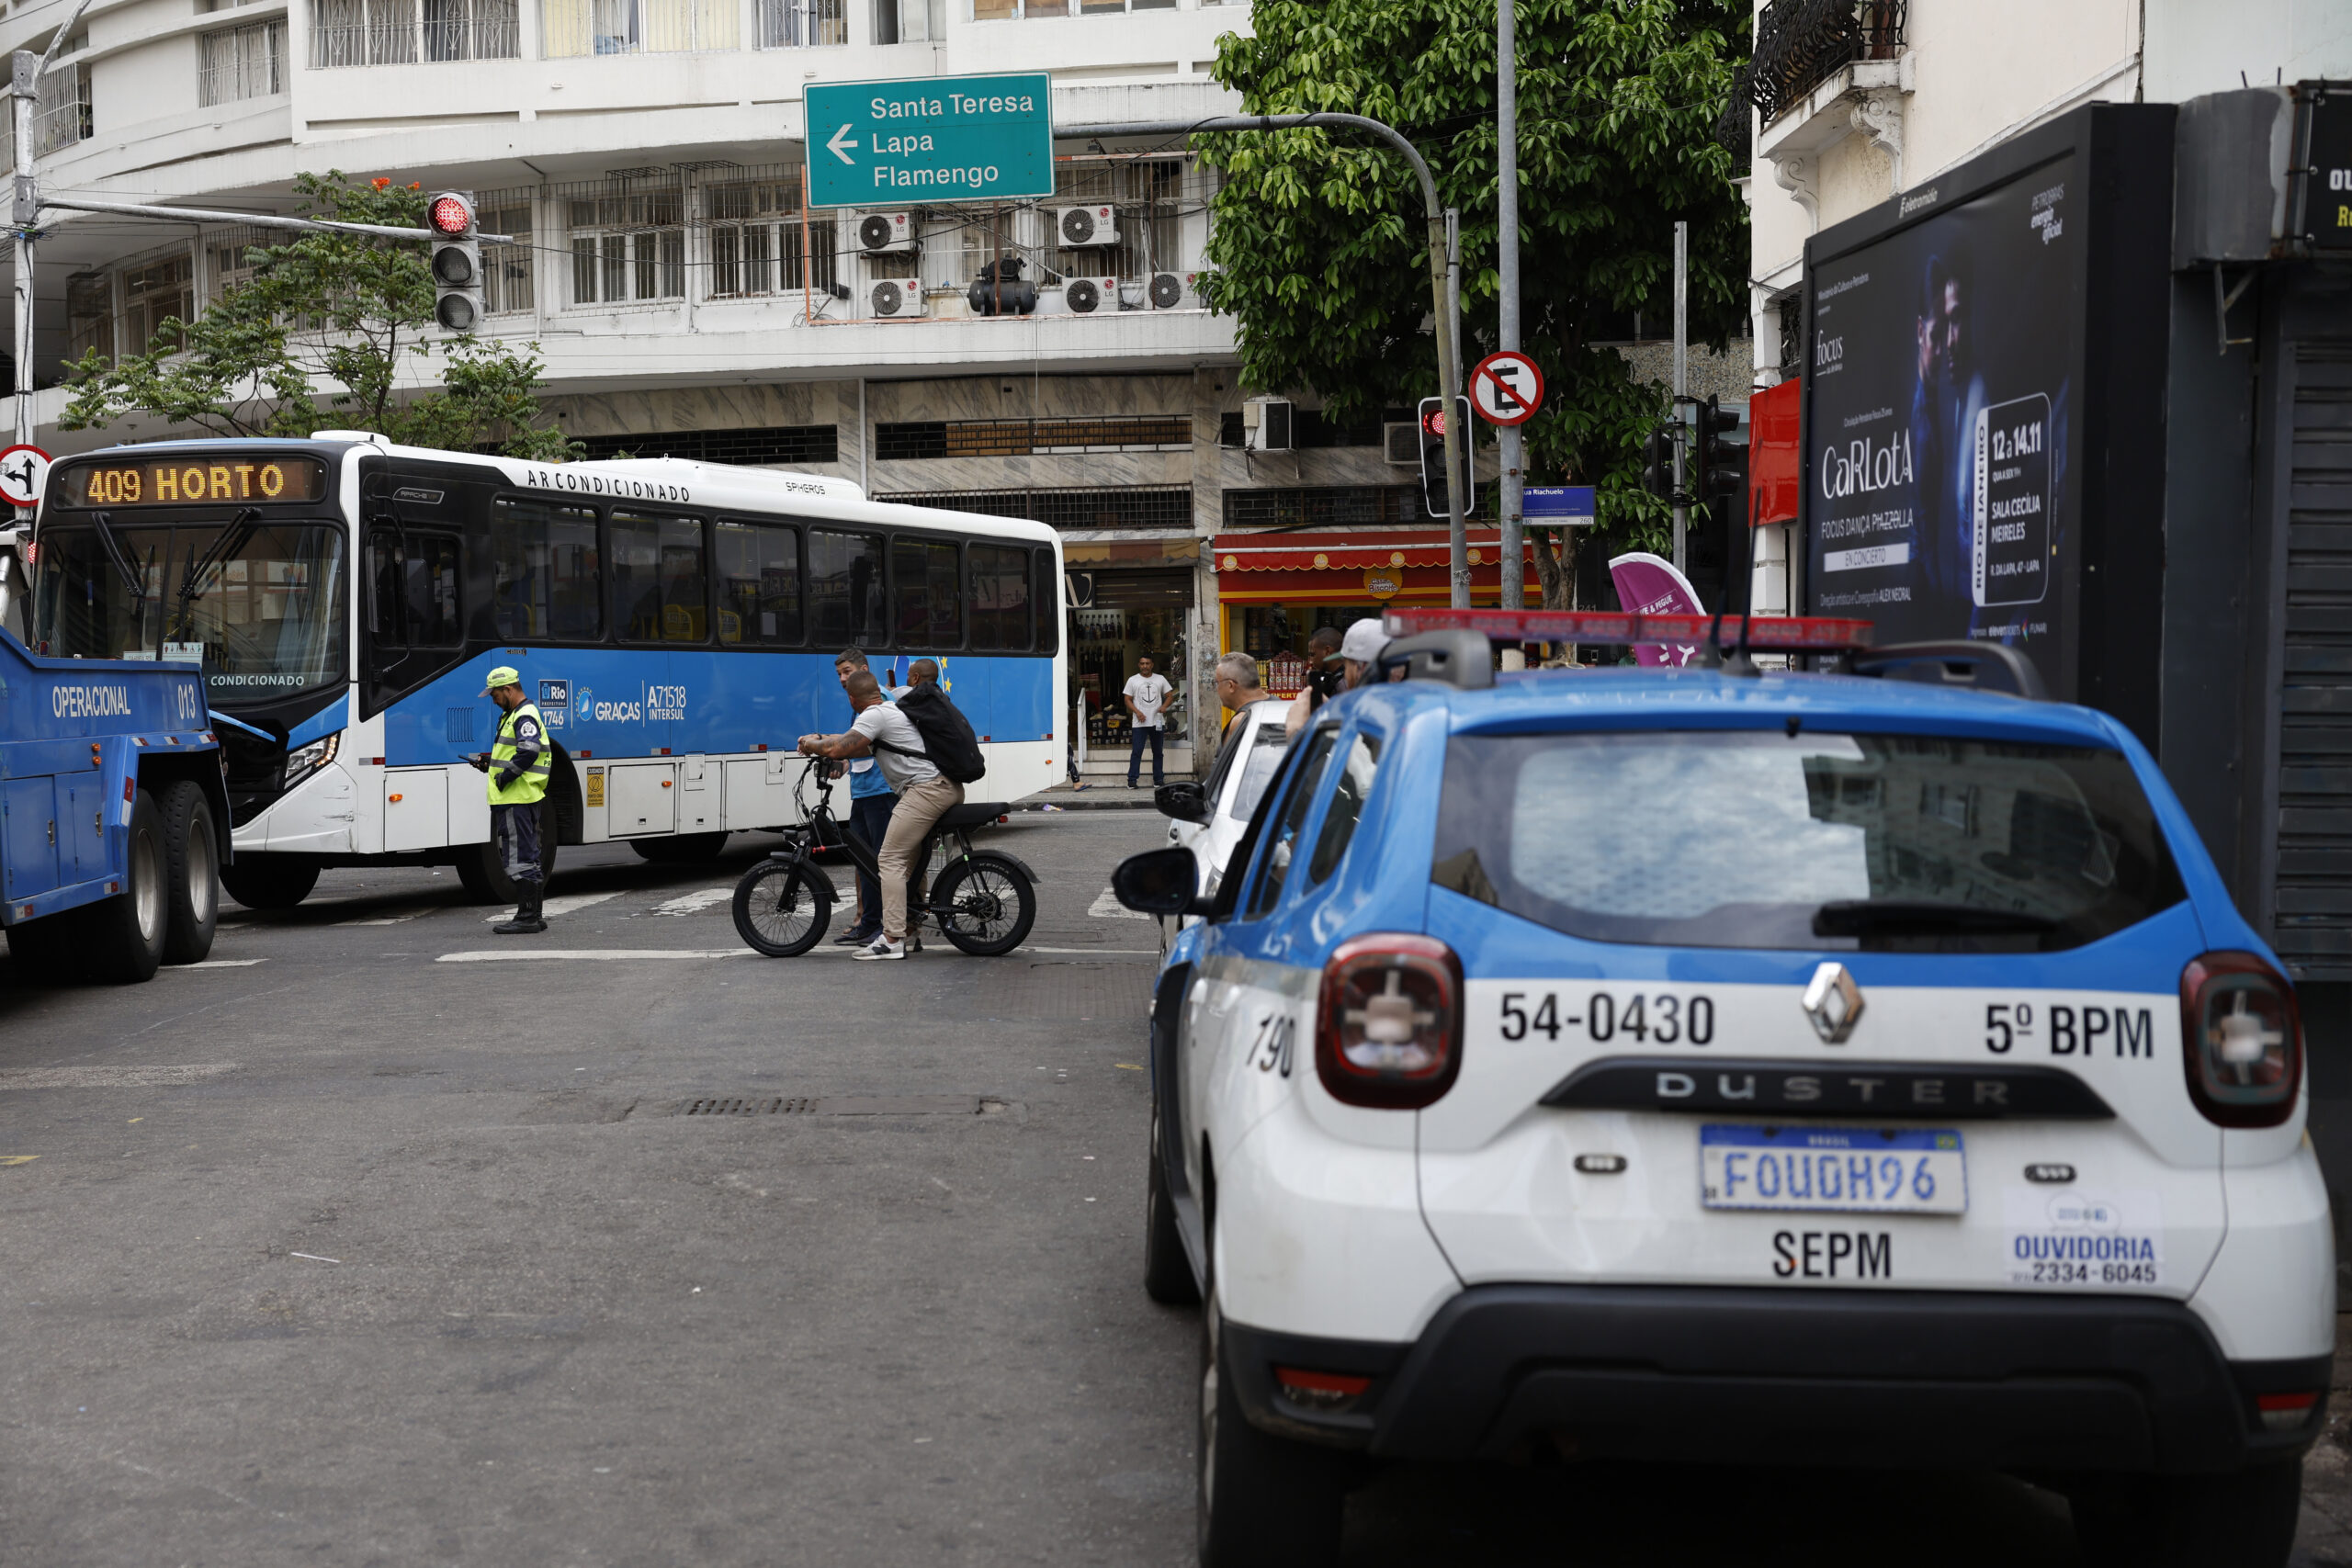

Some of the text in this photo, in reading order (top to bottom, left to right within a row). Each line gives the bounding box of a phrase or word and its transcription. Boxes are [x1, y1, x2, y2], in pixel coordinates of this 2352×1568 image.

[870, 93, 1035, 119] Santa Teresa
[872, 132, 934, 157] Lapa
[873, 165, 999, 188] Flamengo
[1817, 329, 1843, 367] focus
[1992, 421, 2041, 461] 12 a 14.11
[88, 464, 284, 502] 409 HORTO
[786, 481, 826, 495] SPHEROS
[1991, 492, 2041, 520] SALA CECÍLIA
[1822, 508, 1913, 540] FOCUS DANÇA PIAZZOLLA
[1977, 519, 1984, 546] DE
[1991, 522, 2026, 544] MEIRELES
[1845, 547, 1886, 567] EN CONCIERTO
[1655, 594, 1673, 610] PEGUE
[210, 674, 305, 687] CONDICIONADO
[551, 685, 566, 700] Rio
[52, 685, 131, 718] OPERACIONAL
[177, 683, 197, 721] 013
[647, 685, 687, 709] A71518
[542, 710, 564, 727] 1746
[595, 701, 641, 724] GRAÇAS
[649, 708, 684, 721] INTERSUL
[1499, 991, 1715, 1047] 54-0430
[1984, 1003, 2154, 1058] 5º BPM
[1246, 1011, 1296, 1079] 190
[1656, 1071, 2009, 1104] DUSTER
[1807, 1134, 1851, 1147] BRASIL
[1772, 1230, 1893, 1279] SEPM
[2015, 1235, 2154, 1261] OUVIDORIA
[2032, 1261, 2156, 1283] 2334-6045
